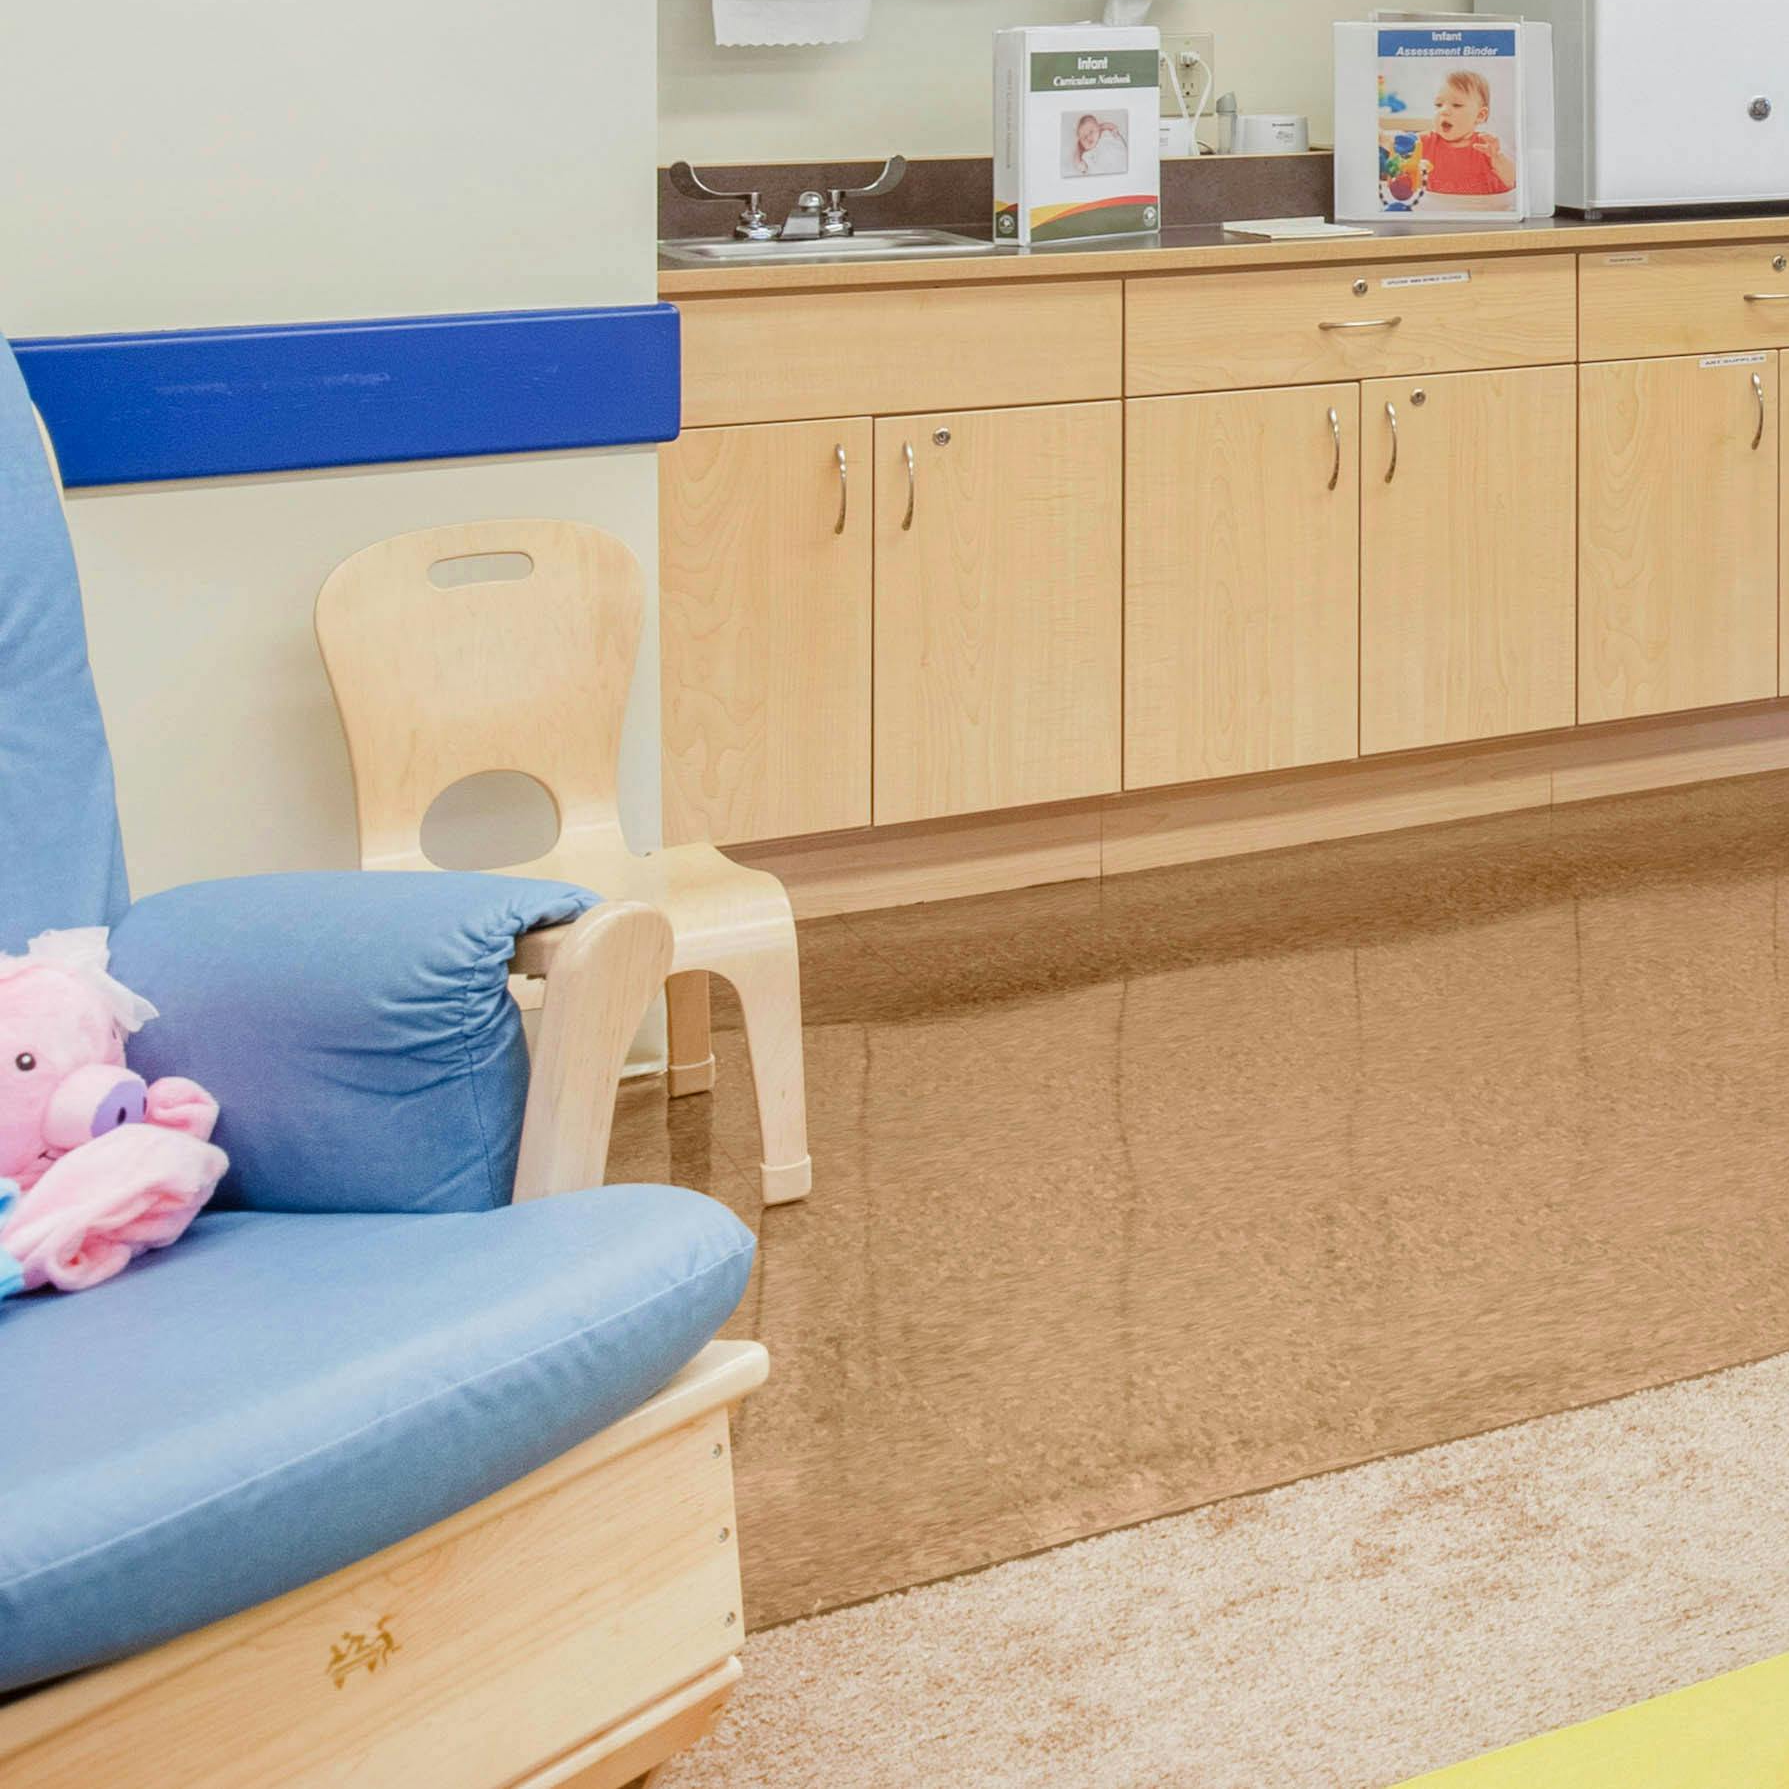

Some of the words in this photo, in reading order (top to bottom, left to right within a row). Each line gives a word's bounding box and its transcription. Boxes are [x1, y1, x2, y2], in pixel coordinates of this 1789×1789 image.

[1432, 31, 1462, 41] Infant
[1395, 46, 1461, 56] Assessment
[1462, 45, 1498, 56] Binder
[1077, 57, 1108, 70] Infant
[1053, 75, 1097, 87] Curriculum
[1097, 74, 1131, 85] Notebook
